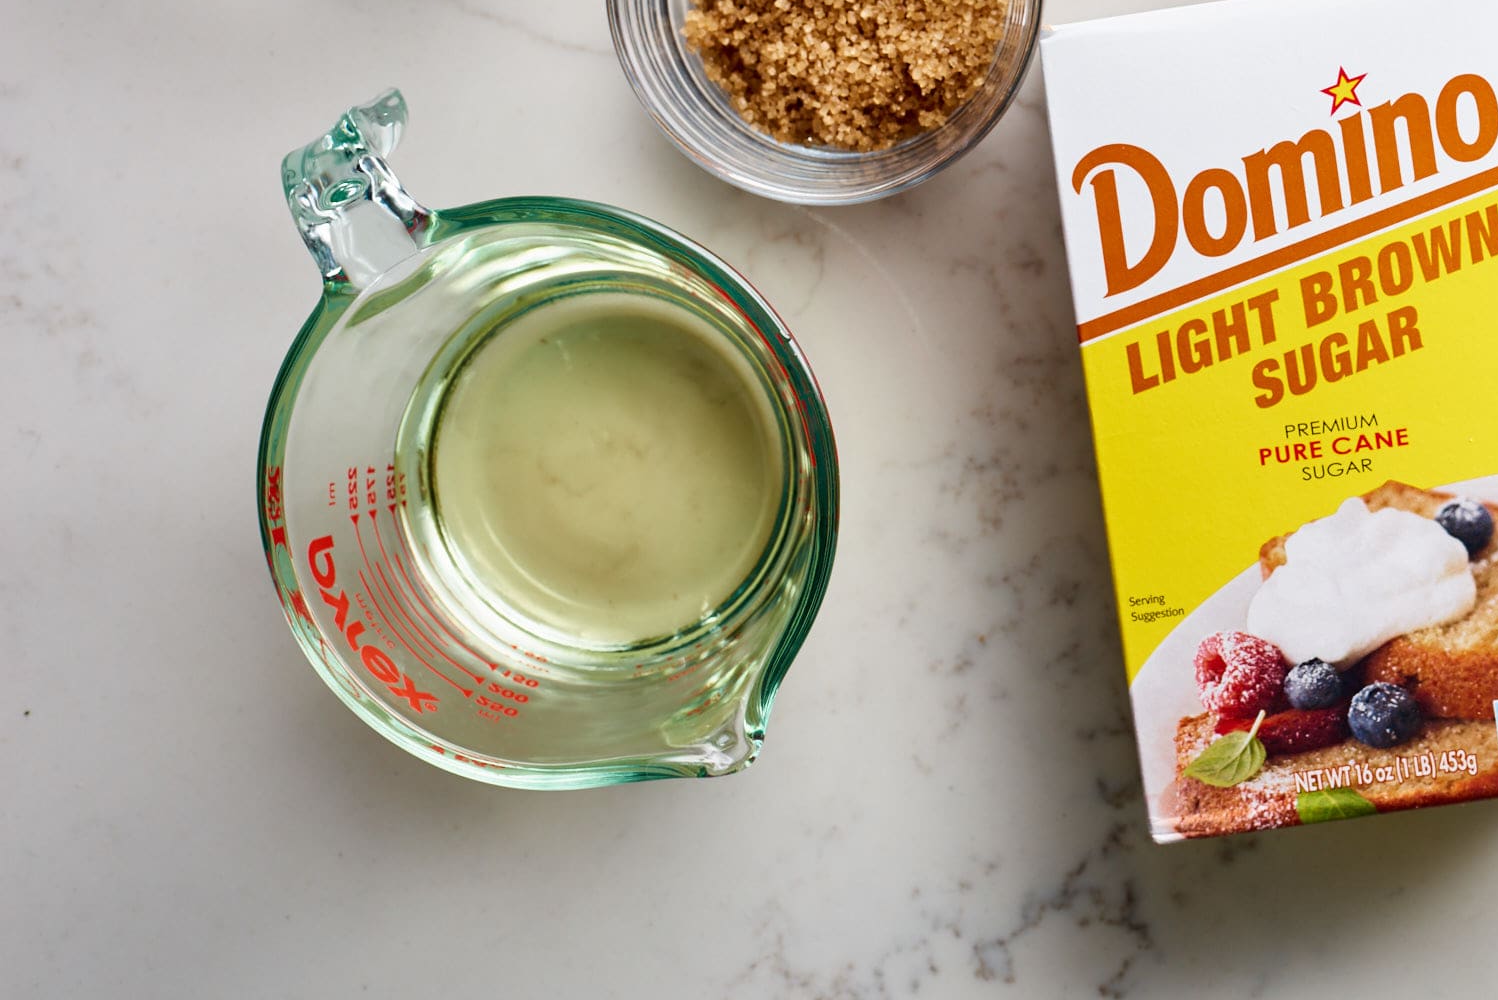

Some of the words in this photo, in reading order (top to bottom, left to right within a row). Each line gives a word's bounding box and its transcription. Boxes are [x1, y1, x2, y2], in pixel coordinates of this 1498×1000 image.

[1126, 289, 1280, 396] LIGHT
[1251, 304, 1424, 410] SUGAR
[1284, 412, 1380, 440] PREMIUM
[1258, 438, 1324, 467] PURE
[1331, 427, 1410, 457] CANE
[1301, 457, 1374, 482] SUGAR
[1128, 592, 1166, 609] Serving
[1131, 605, 1185, 623] Suggestion
[1295, 768, 1327, 793] NET
[1326, 765, 1352, 789] WT
[1353, 763, 1374, 785] 16
[1375, 765, 1394, 783] oz
[1396, 758, 1412, 784] (1
[1413, 756, 1438, 781] LB)
[1439, 750, 1478, 776] 453g
